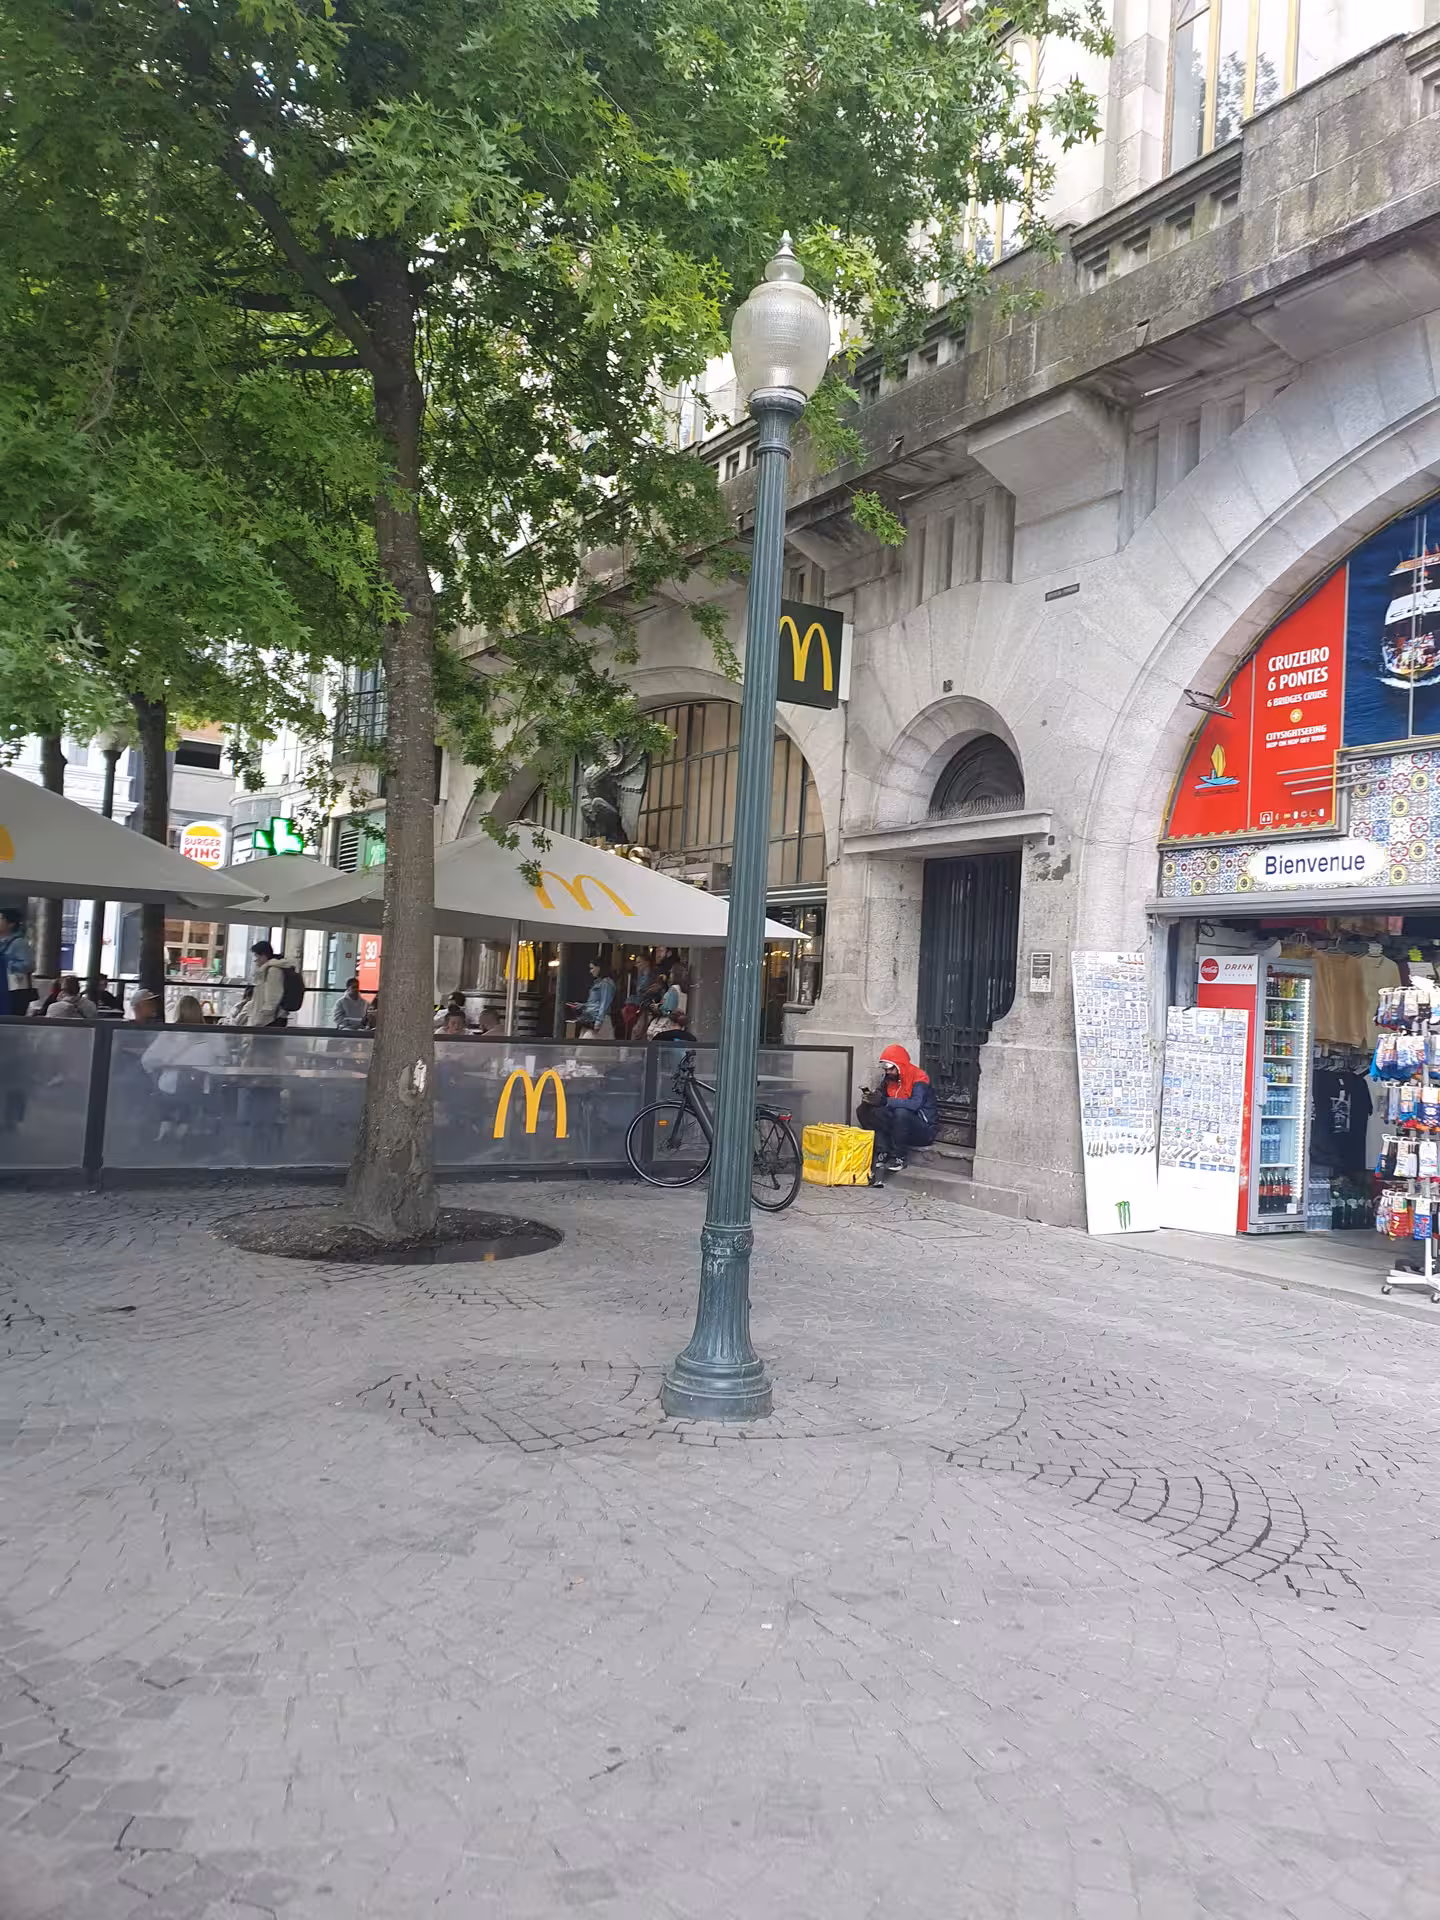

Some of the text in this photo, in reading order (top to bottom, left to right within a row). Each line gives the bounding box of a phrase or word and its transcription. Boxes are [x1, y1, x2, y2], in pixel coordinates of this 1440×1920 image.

[1268, 646, 1329, 672] CRUZEIRO
[1267, 666, 1328, 692] 6 PONTES
[1266, 688, 1329, 708] 6 BRIDGES CRUISE
[1266, 724, 1327, 741] CITYSIGHTSEEING
[184, 837, 221, 847] BURGER
[183, 847, 221, 860] KING
[1264, 854, 1366, 875] Bienvenue
[1224, 963, 1255, 971] DRINK
